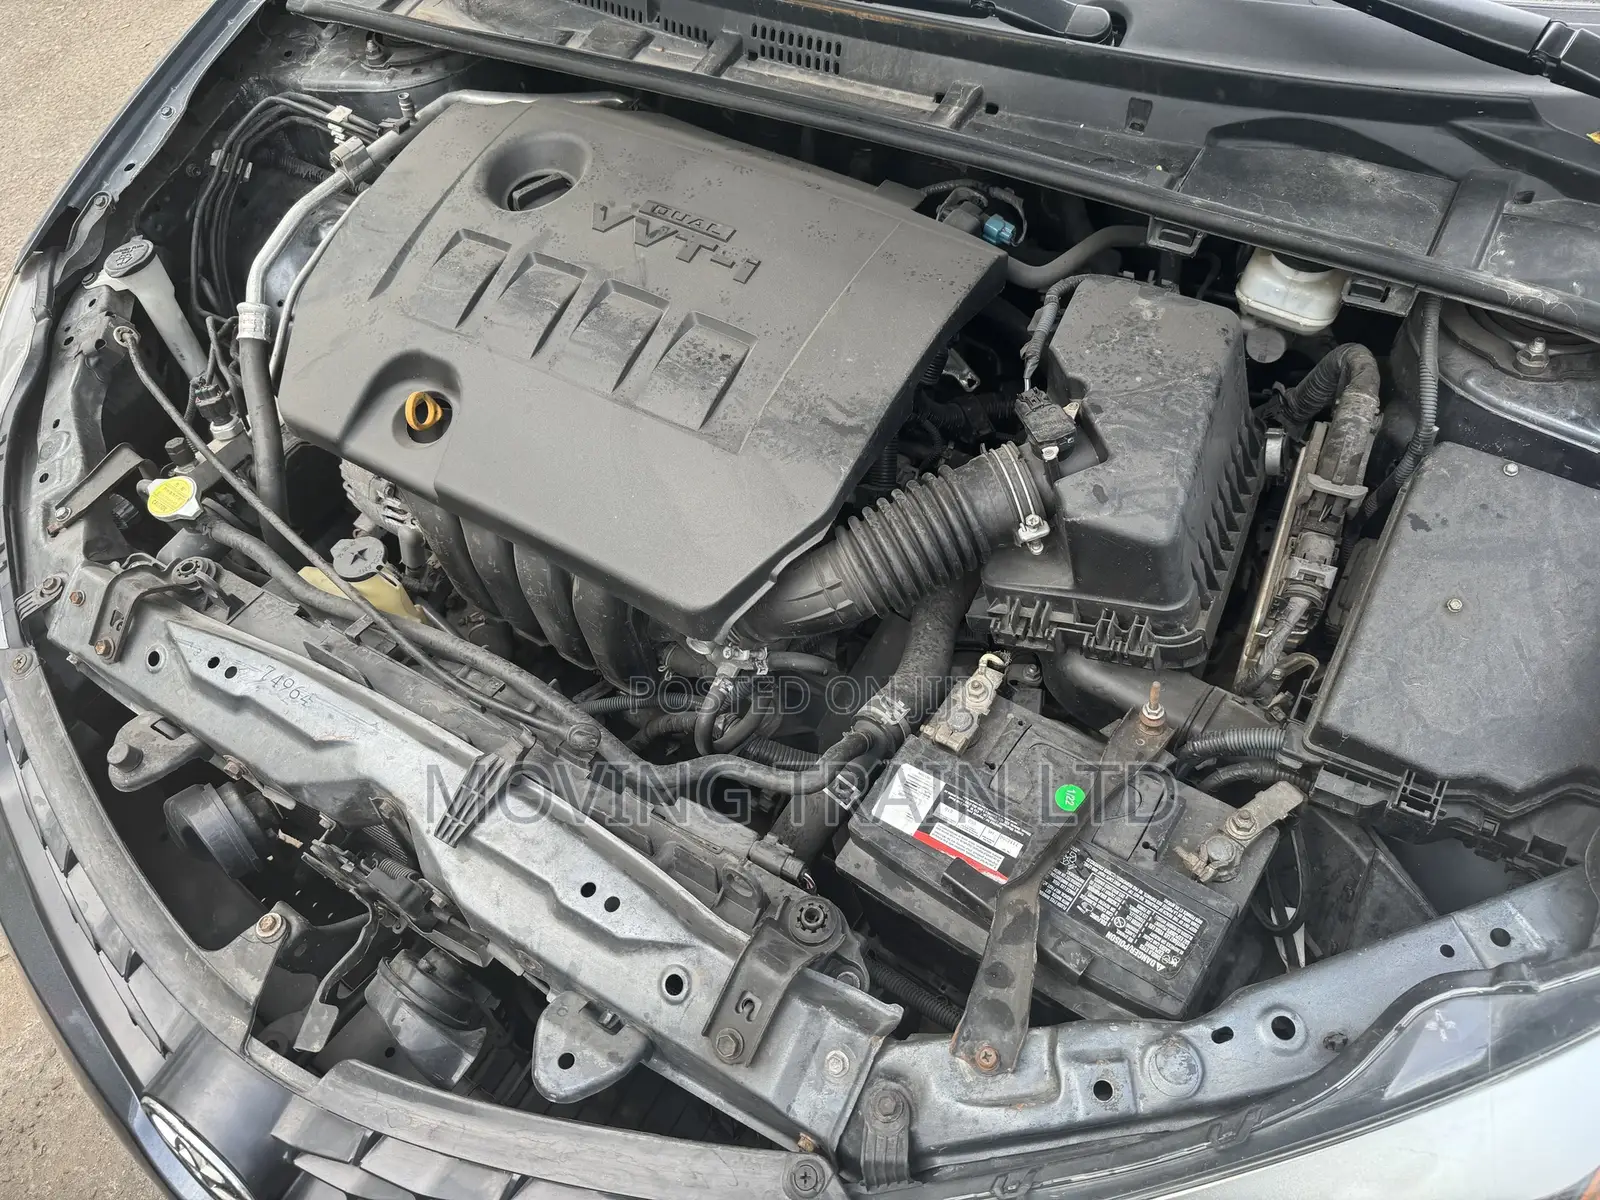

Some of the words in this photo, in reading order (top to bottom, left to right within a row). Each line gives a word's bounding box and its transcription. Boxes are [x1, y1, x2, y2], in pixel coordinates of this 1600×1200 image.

[651, 203, 721, 236] DUAL
[1065, 789, 1077, 806] 1/22
[1104, 930, 1157, 967] DANGER/POISON
